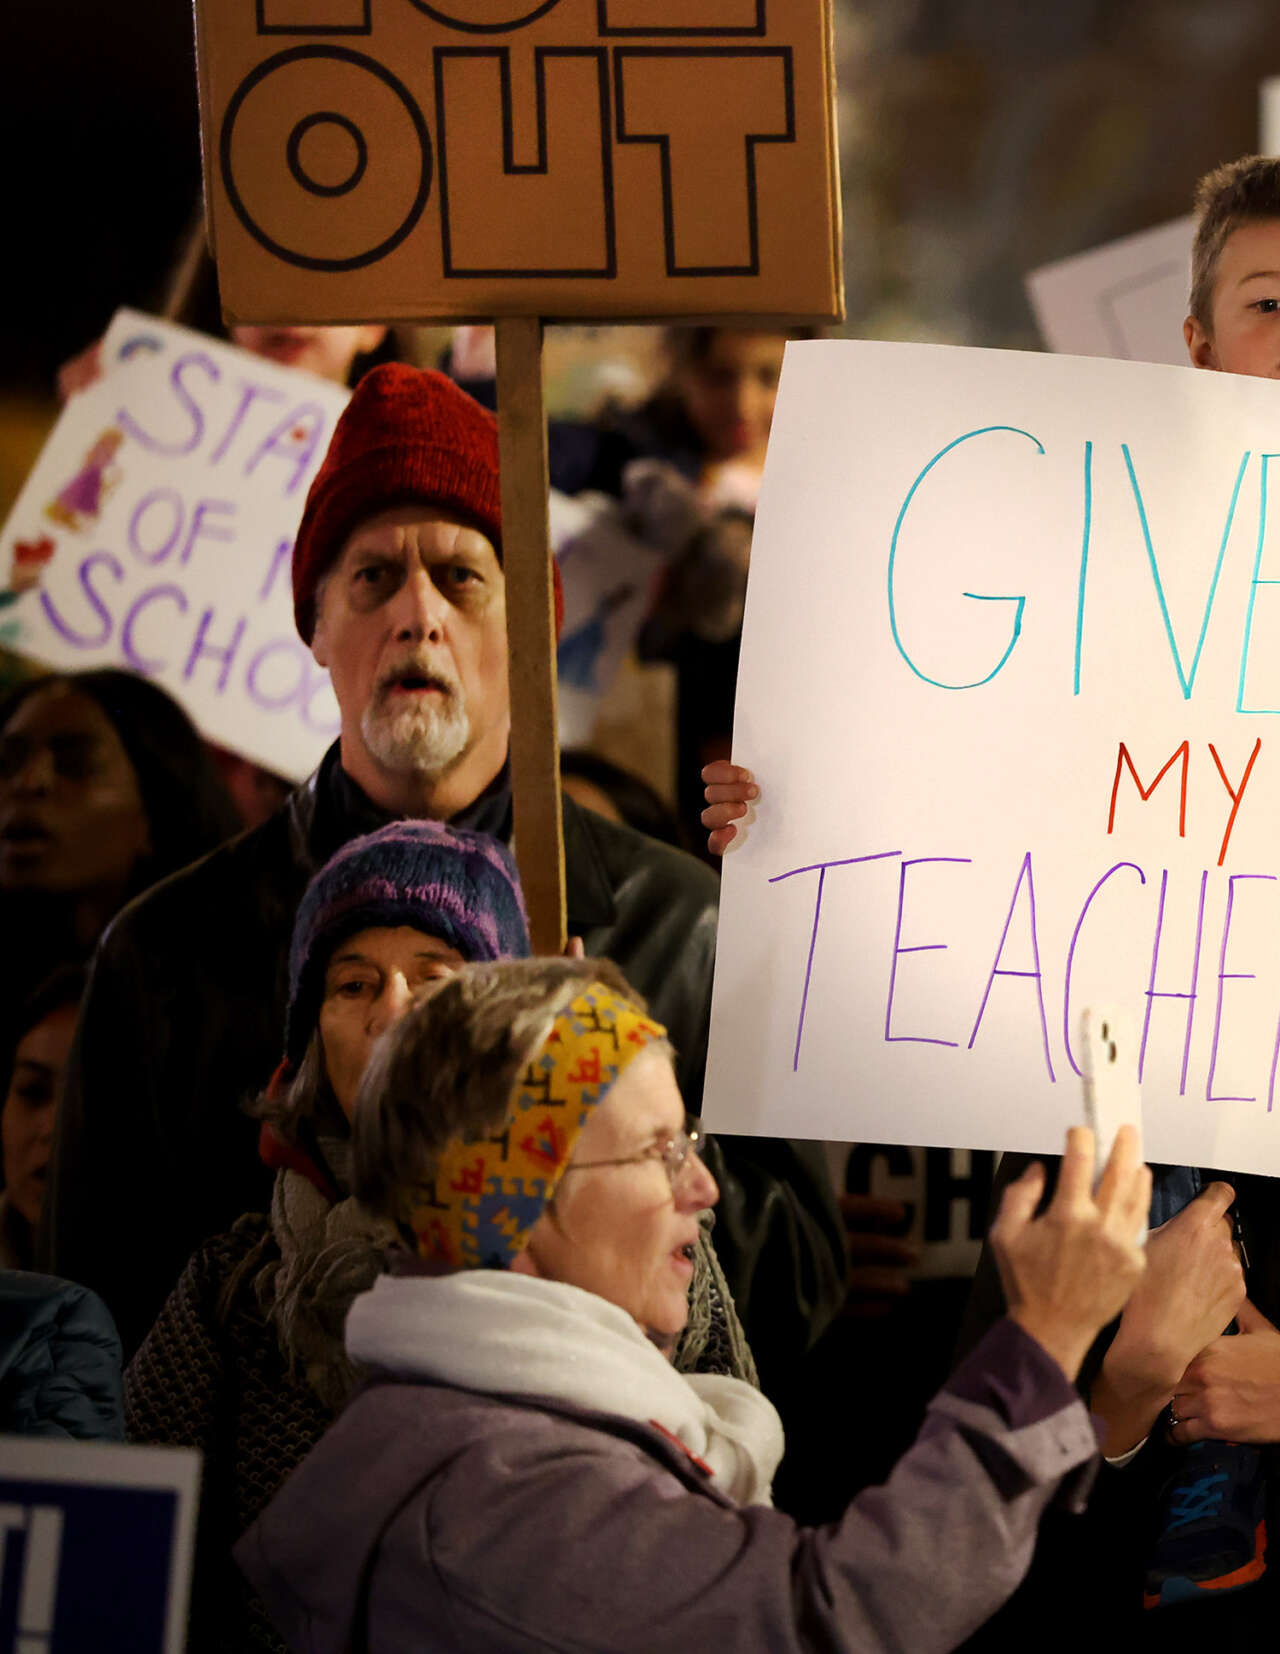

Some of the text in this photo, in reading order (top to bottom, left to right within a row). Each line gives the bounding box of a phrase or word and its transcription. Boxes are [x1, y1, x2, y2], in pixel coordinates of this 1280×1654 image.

[220, 44, 796, 279] OUT
[116, 350, 326, 496] STA
[127, 488, 236, 567] OF
[40, 549, 341, 735] SCHOO
[1107, 737, 1261, 867] MY
